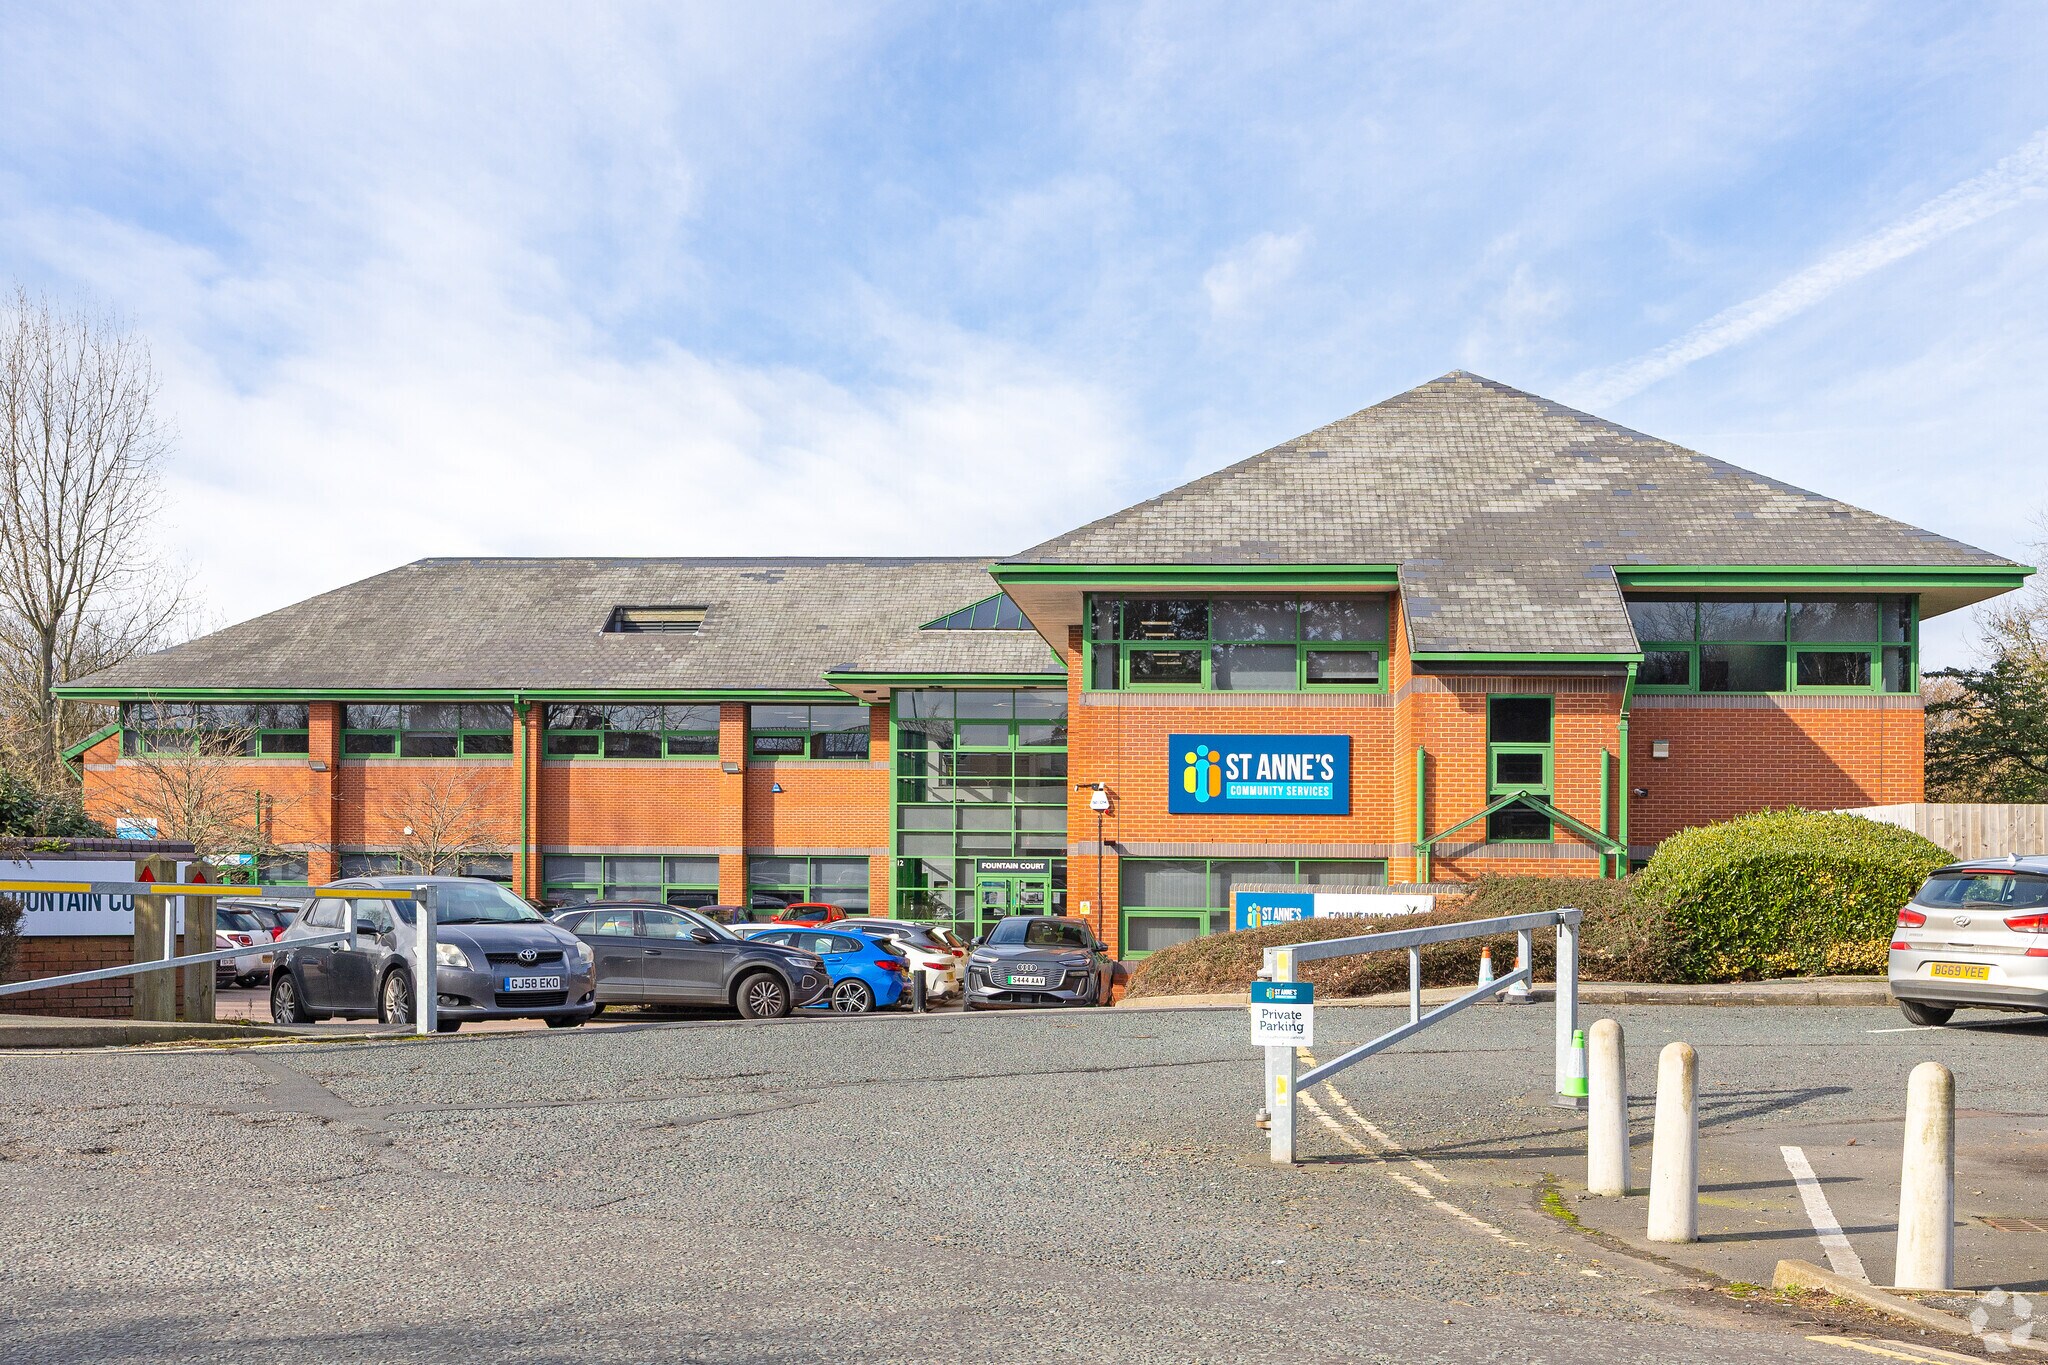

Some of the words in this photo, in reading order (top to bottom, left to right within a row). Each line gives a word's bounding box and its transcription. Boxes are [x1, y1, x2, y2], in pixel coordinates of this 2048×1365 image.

[1226, 753, 1252, 780] ST
[1256, 754, 1334, 781] ANNE'S
[1230, 785, 1283, 796] COMMUNITY
[1286, 786, 1329, 796] SERVICES
[0, 891, 101, 911] UNTAIN
[1262, 907, 1272, 920] ST
[1273, 907, 1302, 921] ANNE'S
[1934, 964, 1962, 976] BG69
[1965, 967, 1985, 978] YEE
[511, 979, 537, 989] GJ58
[540, 977, 559, 988] EKO
[1012, 976, 1029, 984] S444
[1261, 1008, 1302, 1020] Private
[1260, 1020, 1304, 1034] Parking
